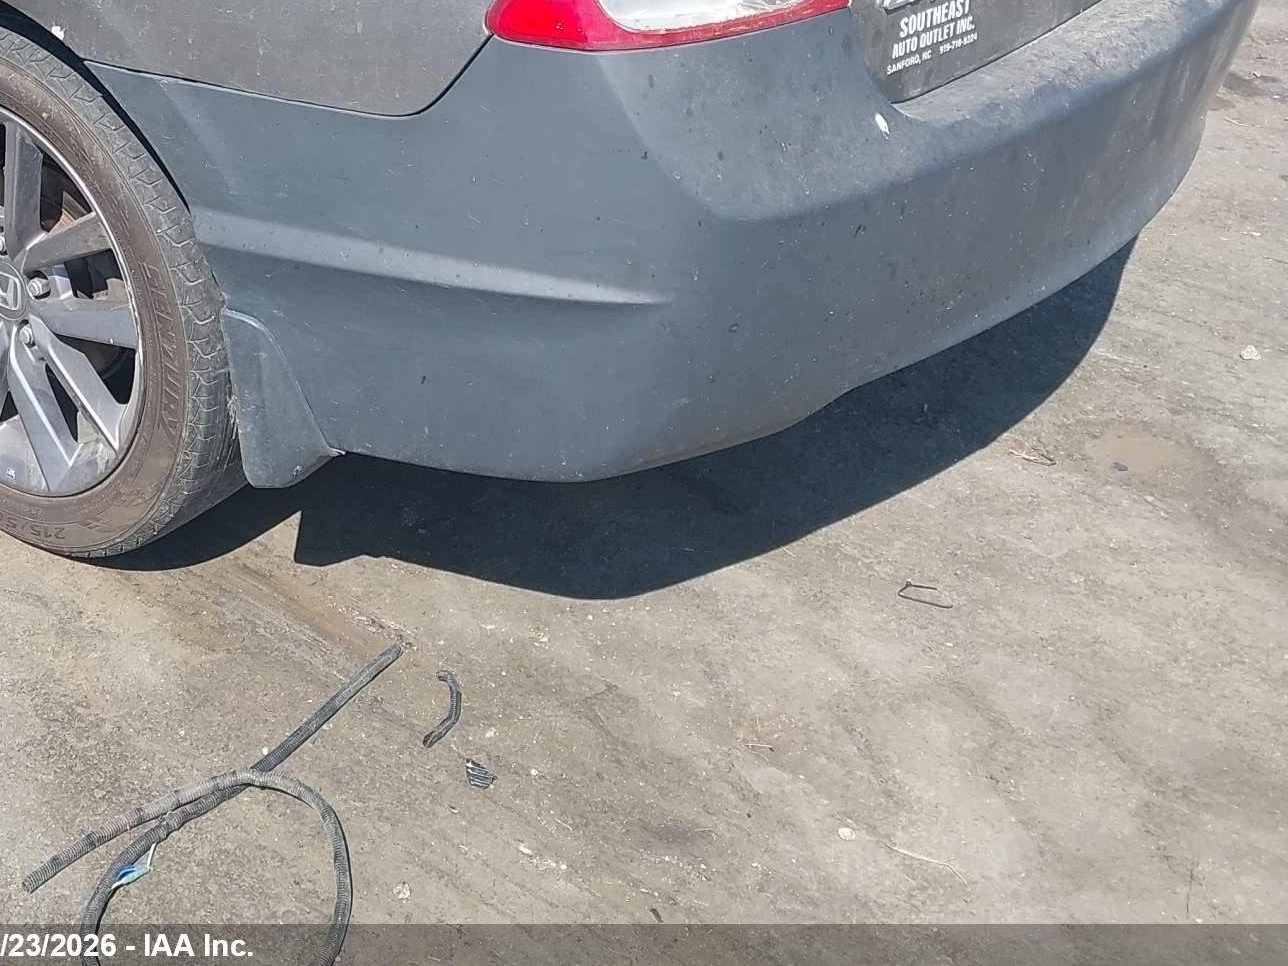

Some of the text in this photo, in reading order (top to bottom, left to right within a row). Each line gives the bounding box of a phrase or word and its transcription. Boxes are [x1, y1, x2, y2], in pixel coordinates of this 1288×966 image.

[892, 16, 976, 59] AUTO OUTLET INC.
[887, 54, 921, 75] SANFORD,
[922, 50, 932, 61] NC
